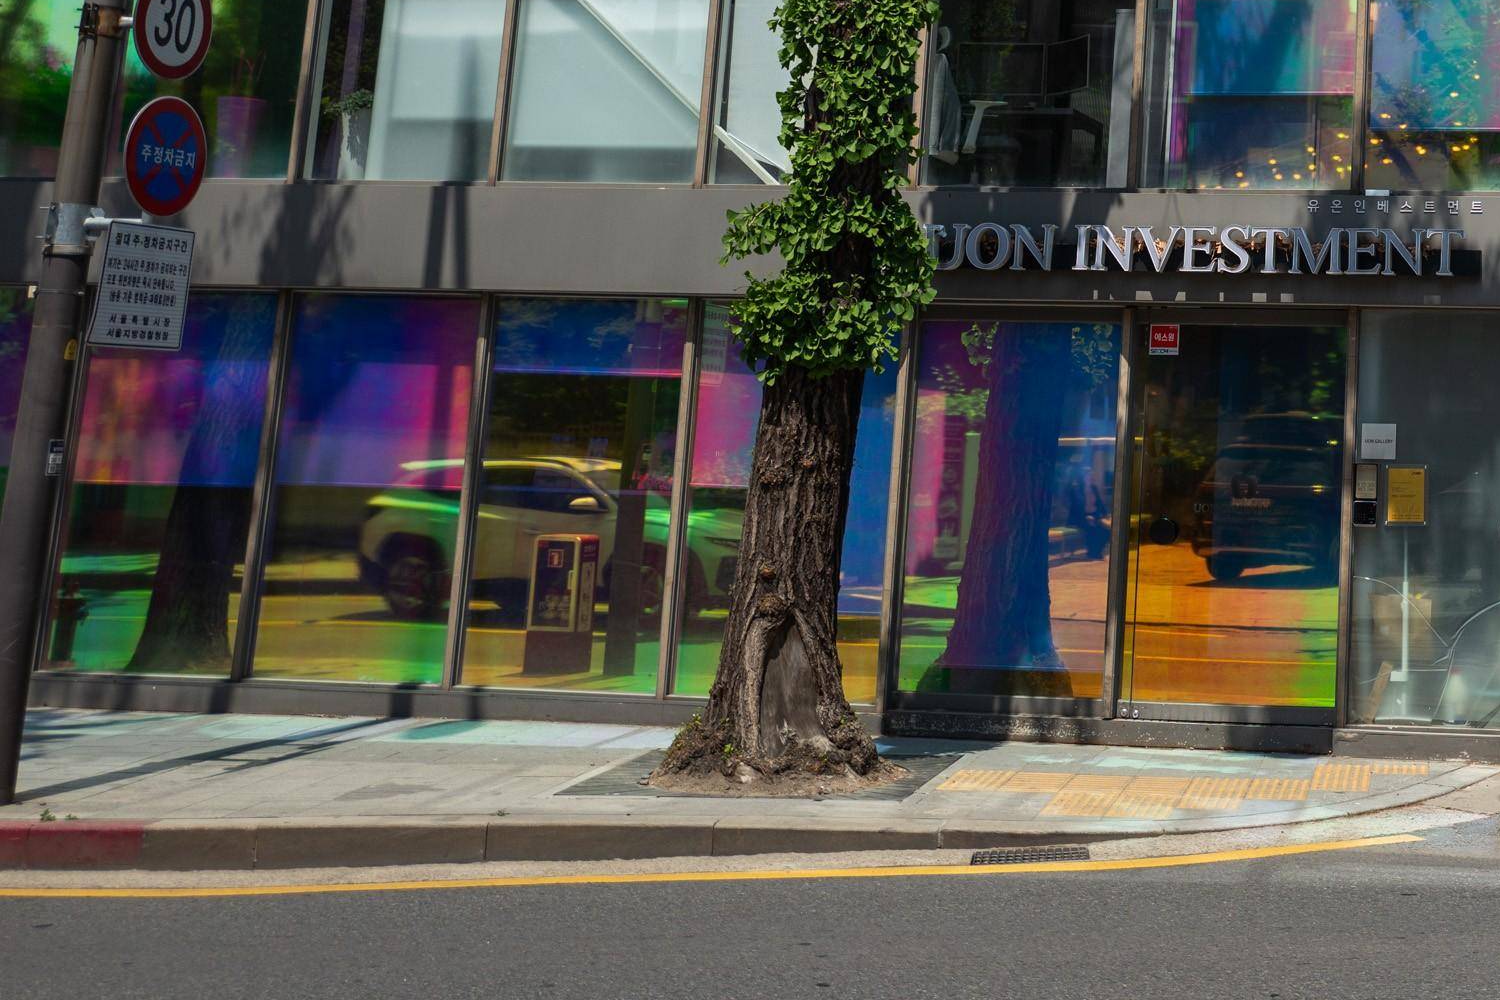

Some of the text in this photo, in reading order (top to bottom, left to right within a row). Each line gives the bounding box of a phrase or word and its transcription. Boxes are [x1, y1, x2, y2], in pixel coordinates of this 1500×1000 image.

[141, 144, 197, 170] 주정차금지
[1307, 199, 1483, 217] 유온인베스트먼트
[1071, 223, 1465, 277] INVESTMENT
